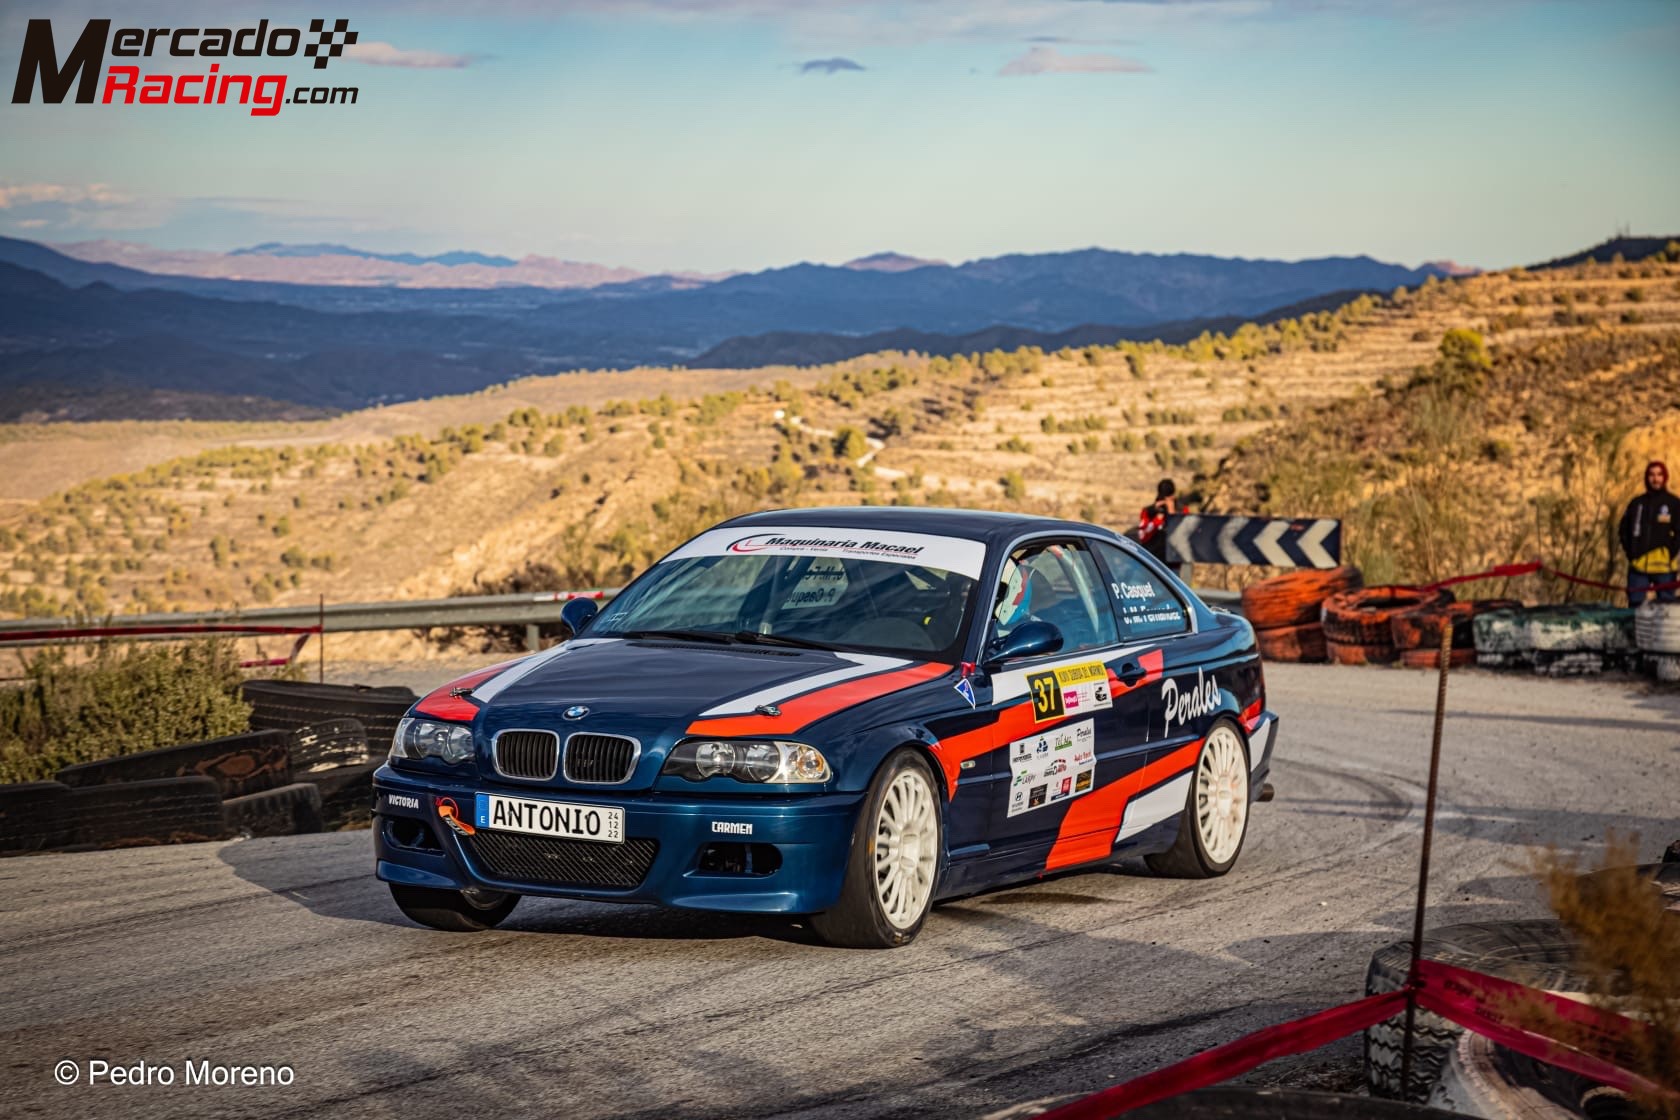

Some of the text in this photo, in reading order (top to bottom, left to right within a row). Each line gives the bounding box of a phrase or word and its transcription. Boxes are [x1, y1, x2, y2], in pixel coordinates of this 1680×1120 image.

[765, 537, 924, 554] Maquinaria Macael
[1034, 677, 1055, 713] 37
[1161, 665, 1222, 738] Perales
[388, 794, 419, 809] VICTORIA
[480, 816, 486, 824] E
[493, 799, 600, 836] ANTONIO
[608, 811, 619, 820] 24
[608, 820, 619, 829] 12
[711, 821, 753, 835] CARMEN
[608, 830, 619, 838] 22
